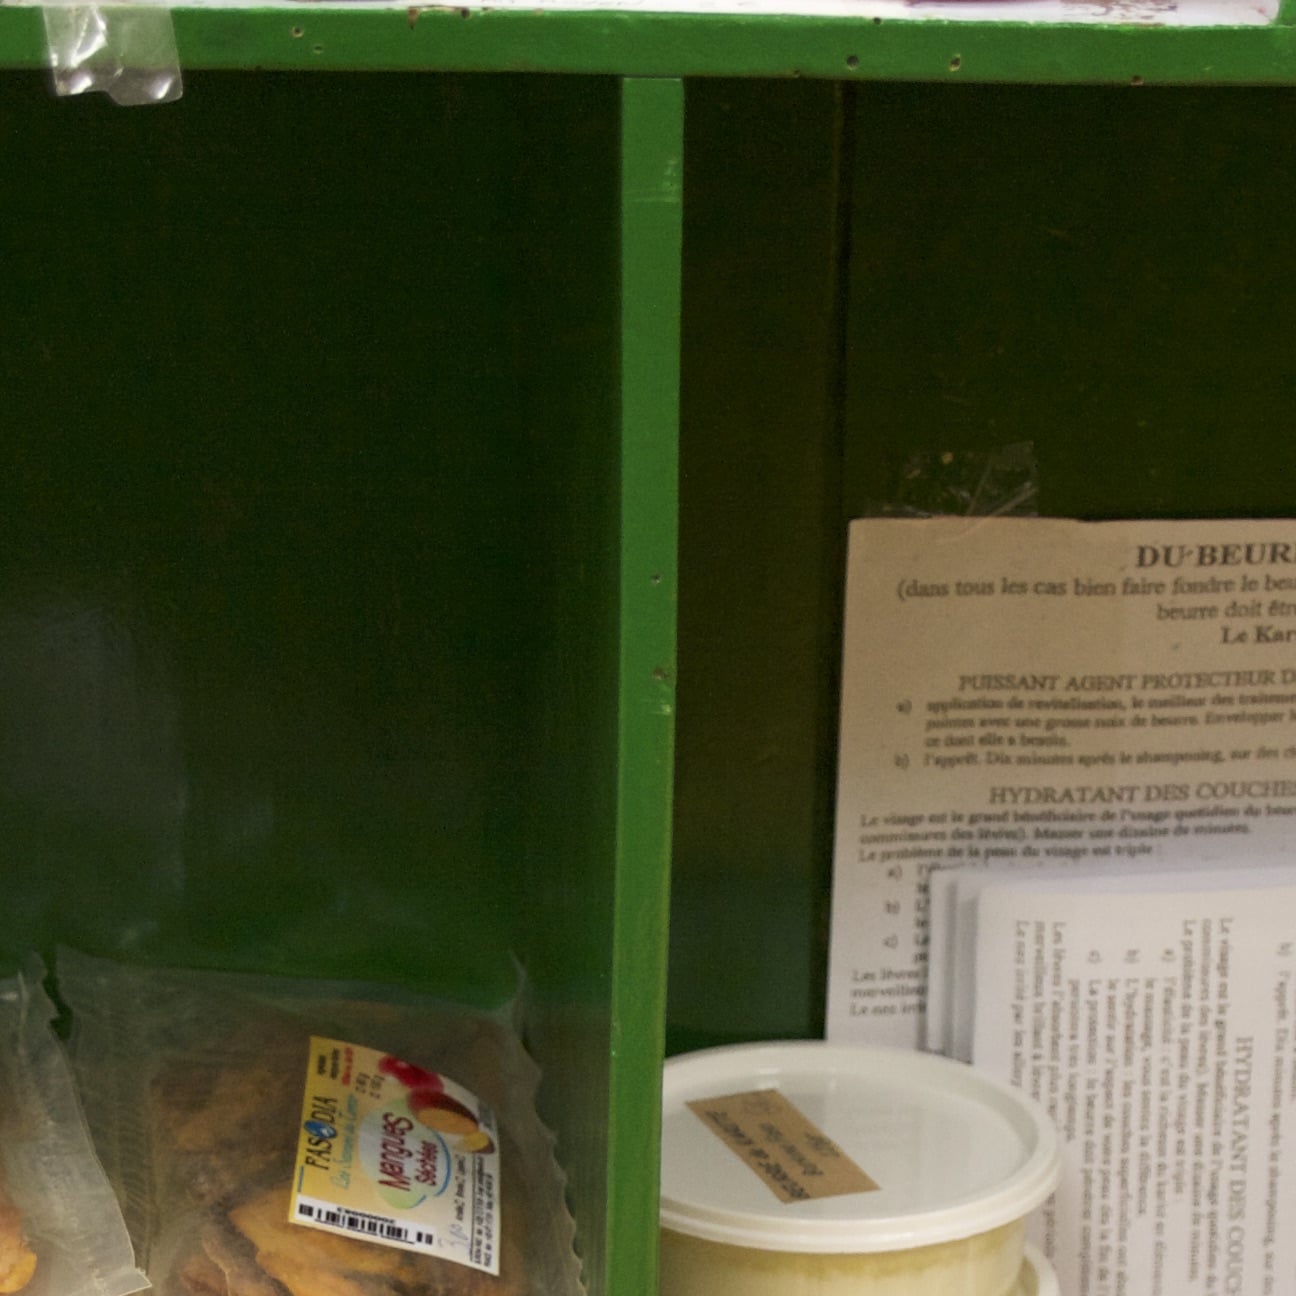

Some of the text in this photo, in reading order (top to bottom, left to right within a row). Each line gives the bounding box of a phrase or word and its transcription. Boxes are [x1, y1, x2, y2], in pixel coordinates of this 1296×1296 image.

[1136, 545, 1189, 568] DU
[1220, 626, 1249, 644] Le
[957, 673, 1061, 693] PUISSANT
[1065, 674, 1138, 692] AGENT
[1140, 670, 1276, 690] PROTECTEUR
[988, 783, 1142, 807] HYDRATANT
[1143, 783, 1191, 802] DES
[378, 1111, 414, 1192] Mangues
